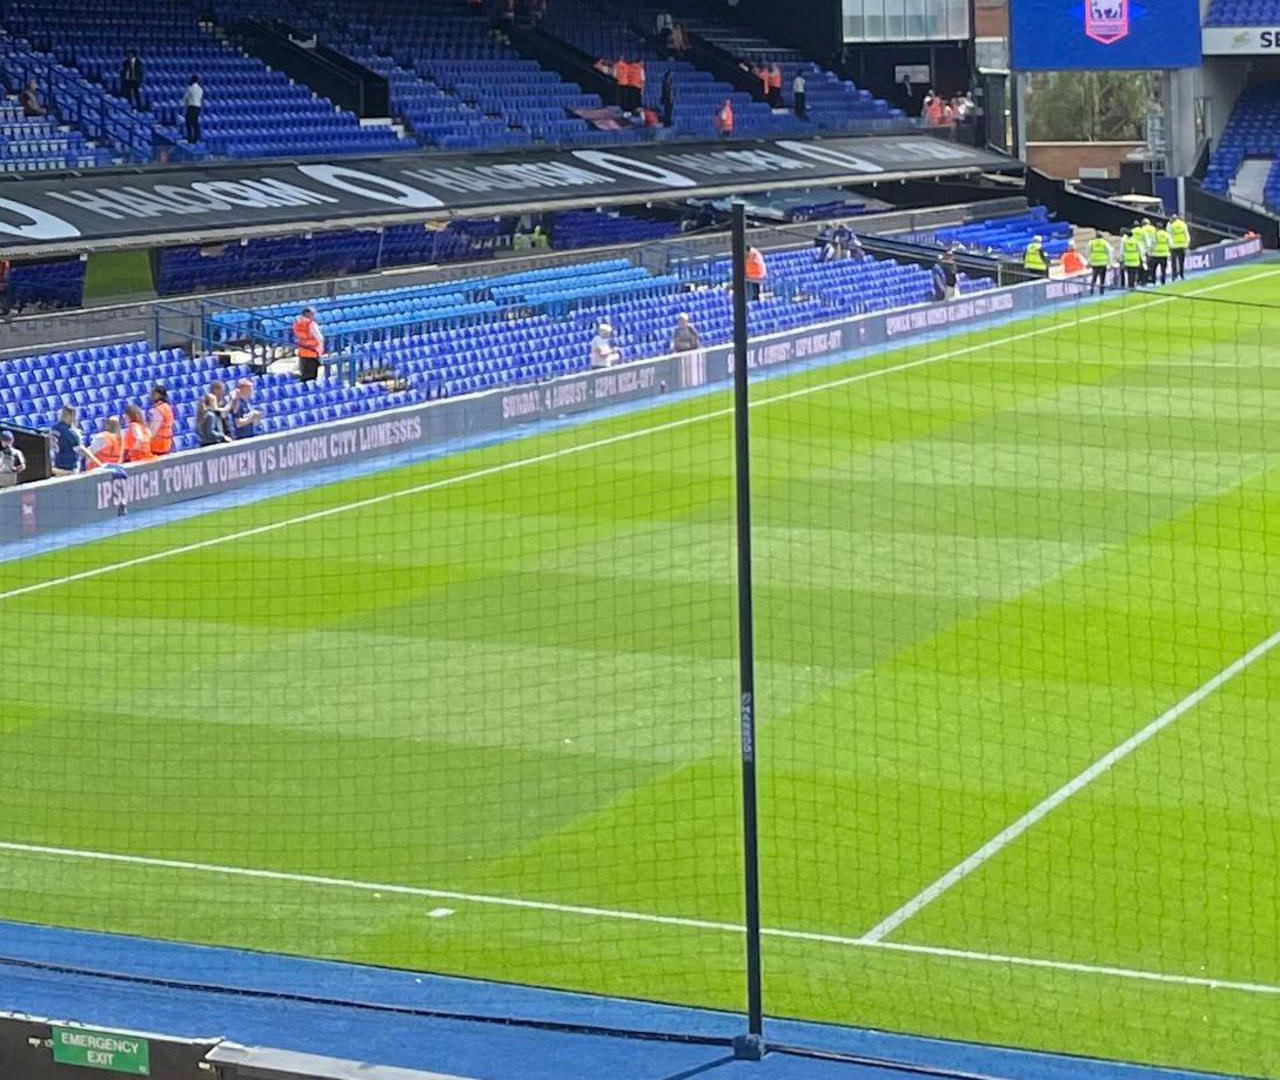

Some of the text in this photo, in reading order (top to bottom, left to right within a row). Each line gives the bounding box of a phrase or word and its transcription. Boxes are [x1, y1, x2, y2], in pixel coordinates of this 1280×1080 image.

[97, 416, 422, 510] IPSWICH TOWN WOMEN VS LONDON CITY LIONESSES
[62, 1033, 139, 1053] EMERGENCY
[89, 1052, 114, 1065] EXIT
